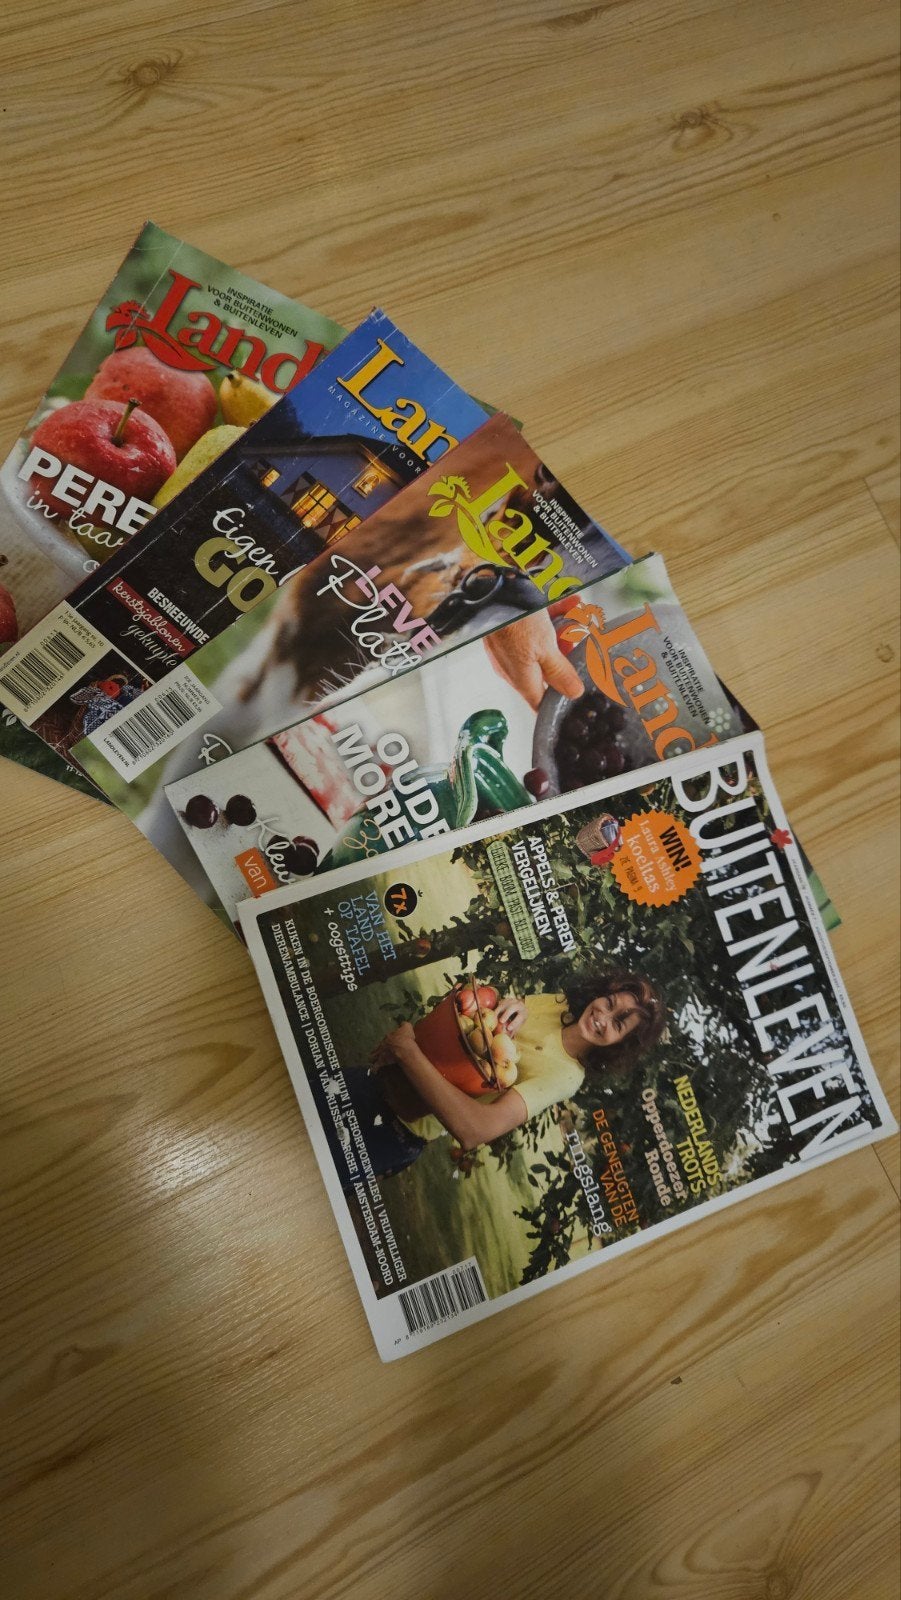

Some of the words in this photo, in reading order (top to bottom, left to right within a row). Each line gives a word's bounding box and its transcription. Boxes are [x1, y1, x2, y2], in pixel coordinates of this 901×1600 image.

[207, 285, 235, 306] VOOR
[233, 299, 299, 338] BUITENWONEN
[213, 298, 221, 306] &
[223, 302, 283, 339] BUITENLEVEN
[227, 286, 273, 315] INSPIRATIE
[327, 385, 386, 440] MAGAZINE
[392, 445, 422, 474] VOOR
[18, 446, 157, 535] PERE
[26, 490, 58, 519] in
[548, 498, 585, 540] INSPIRATIE
[212, 507, 279, 575] Eigen
[531, 489, 554, 515] VOOR
[551, 510, 599, 568] BUITENWONEN
[532, 505, 541, 513] &
[539, 509, 584, 565] BUITENLEVEN
[112, 581, 185, 653] kerstsjablonen
[147, 586, 210, 645] BESNEEUWDE
[661, 651, 668, 660] &
[665, 659, 698, 718] BUITENLEVEN
[663, 635, 679, 662] VOOR
[675, 661, 711, 726] BUITENWONEN
[678, 648, 705, 693] INSPIRATIE
[244, 854, 269, 889] van
[490, 847, 508, 873] WELKE
[527, 836, 556, 889] APPELS
[626, 835, 660, 894] koeltas
[638, 819, 660, 853] Laura
[655, 855, 678, 893] Ashley
[659, 825, 692, 872] WIN!
[338, 901, 353, 921] OP
[499, 874, 517, 897] BOOM
[507, 898, 524, 917] PAST
[511, 840, 553, 936] VERGELIJKEN
[546, 889, 561, 905] &
[285, 918, 303, 956] KIJKEN
[350, 895, 375, 943] LAND
[364, 890, 385, 927] VAN
[376, 929, 397, 962] HET
[550, 904, 577, 953] PEREN
[297, 955, 308, 970] IN
[301, 970, 313, 986] DE
[327, 922, 358, 993] oogsttips
[345, 925, 371, 976] TAFEL
[669, 751, 873, 1161] BUITENLEVEN
[306, 985, 340, 1070] BOERGONDISCHE
[271, 923, 310, 1025] DIERENAMBULANCE
[305, 1028, 326, 1070] DORIAN
[354, 1181, 393, 1285] AMSTERDAM-NOORD
[592, 1108, 609, 1131] DE
[673, 1074, 723, 1187] NEDERLANDS
[346, 1109, 382, 1204] SCHORPIOENVLIEG
[642, 1087, 688, 1201] Opperdoezer
[676, 1136, 706, 1195] TROTS
[566, 1129, 613, 1237] ringslang
[600, 1131, 640, 1222] GENEUGTEN
[600, 1171, 617, 1205] VAN
[610, 1206, 628, 1228] DE
[645, 1148, 672, 1207] Ronde
[377, 1208, 407, 1283] VRIJWILLIGER
